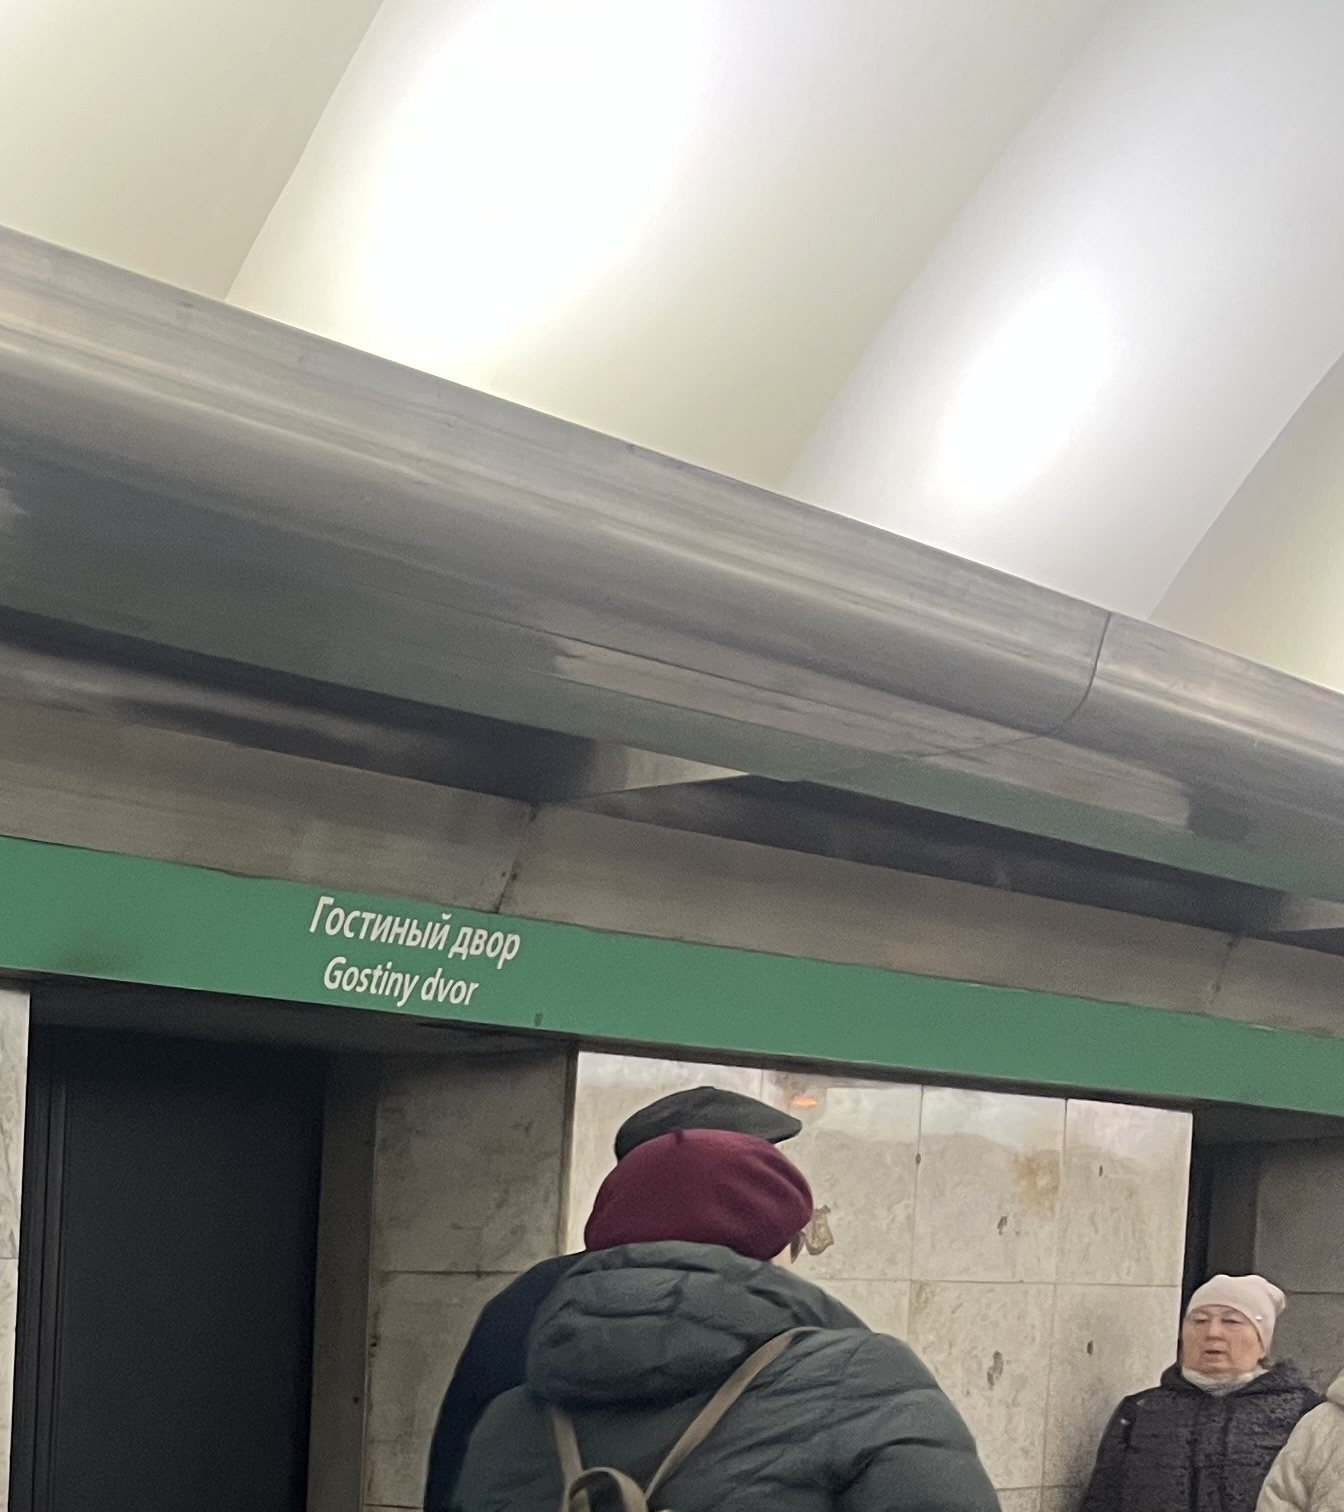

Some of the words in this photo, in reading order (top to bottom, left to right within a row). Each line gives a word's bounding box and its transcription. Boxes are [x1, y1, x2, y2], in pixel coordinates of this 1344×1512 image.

[309, 896, 452, 950] Гостиный
[447, 926, 521, 969] двор
[323, 956, 419, 1007] Gostiny
[420, 968, 479, 1005] dvor
